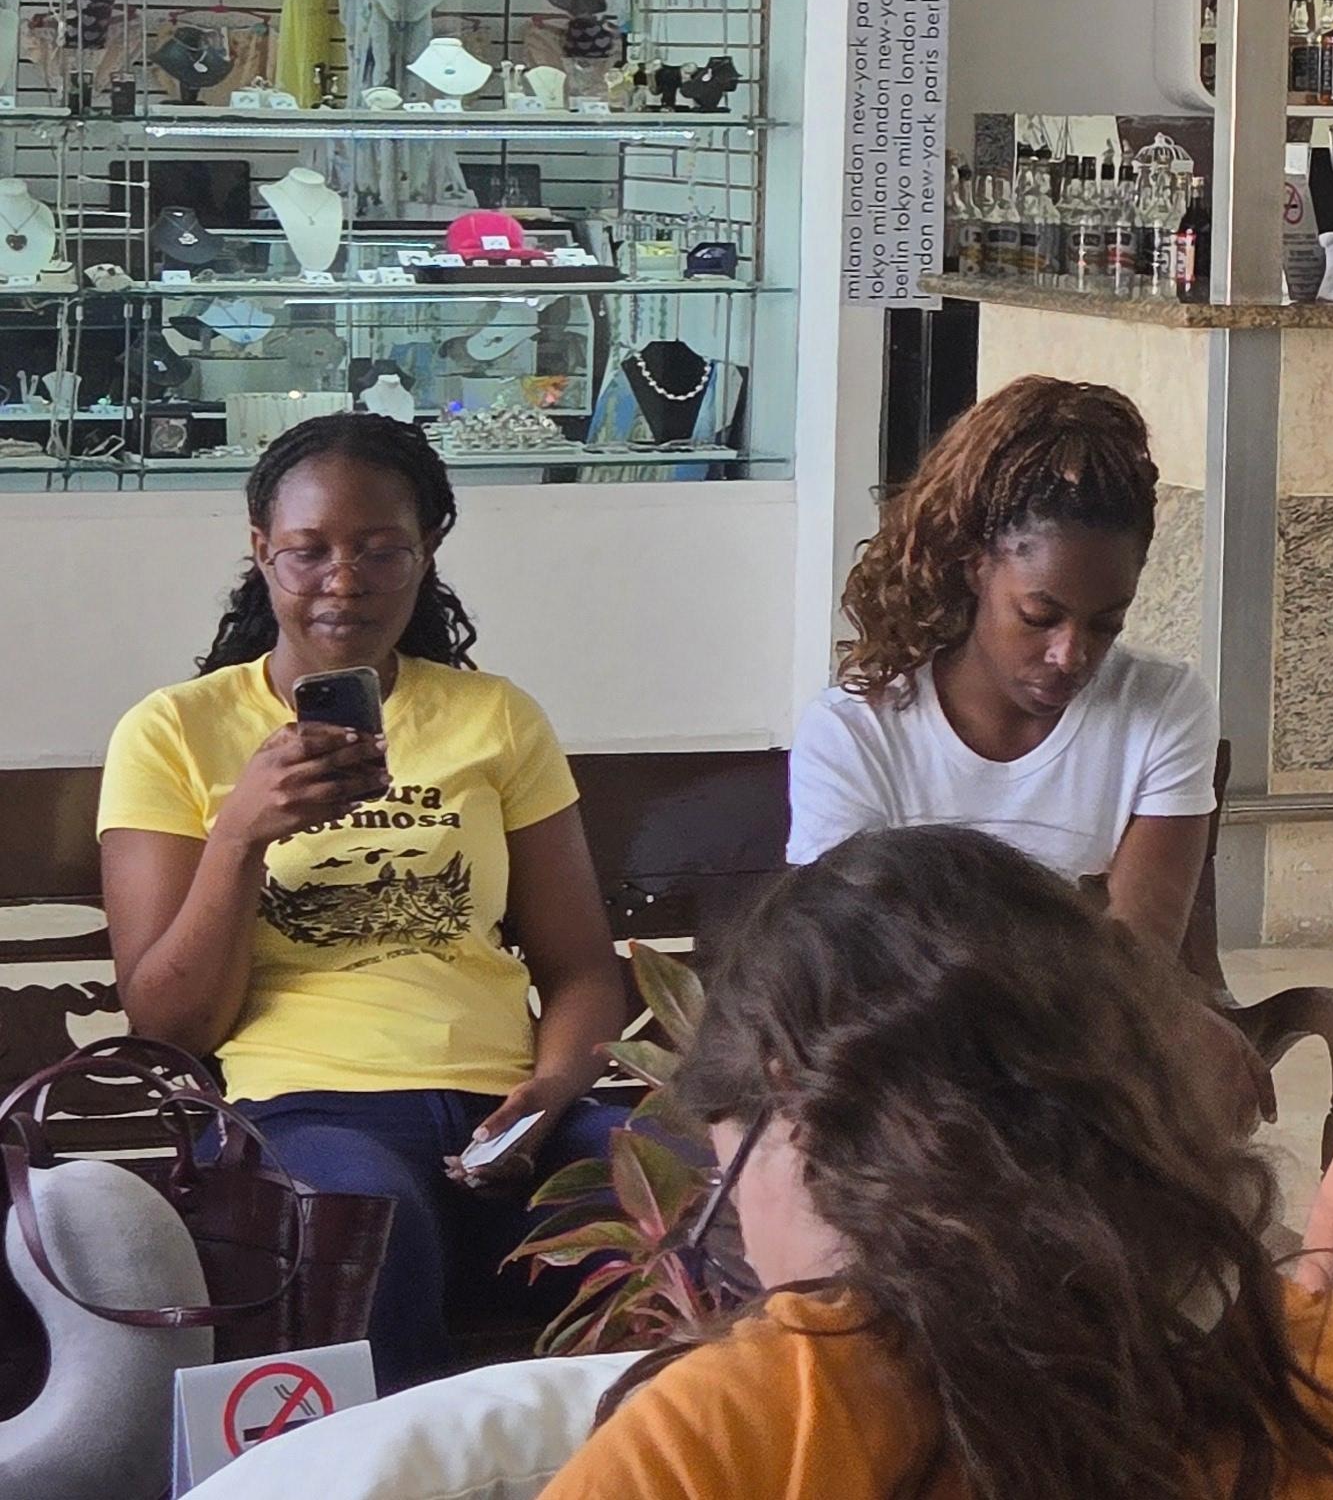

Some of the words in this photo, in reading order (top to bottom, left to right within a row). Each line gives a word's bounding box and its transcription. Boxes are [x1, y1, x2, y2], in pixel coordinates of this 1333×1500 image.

[895, 11, 917, 85] london
[919, 49, 942, 103] paris
[848, 37, 872, 135] new-york
[869, 79, 891, 153] london
[893, 93, 914, 167] milano
[917, 114, 940, 214] new-york
[845, 144, 864, 218] london
[868, 161, 888, 235] milano
[892, 175, 915, 231] tokyo
[842, 227, 863, 300] milano
[866, 244, 890, 300] tokyo
[888, 240, 910, 300] berlin
[913, 224, 934, 299] lndon
